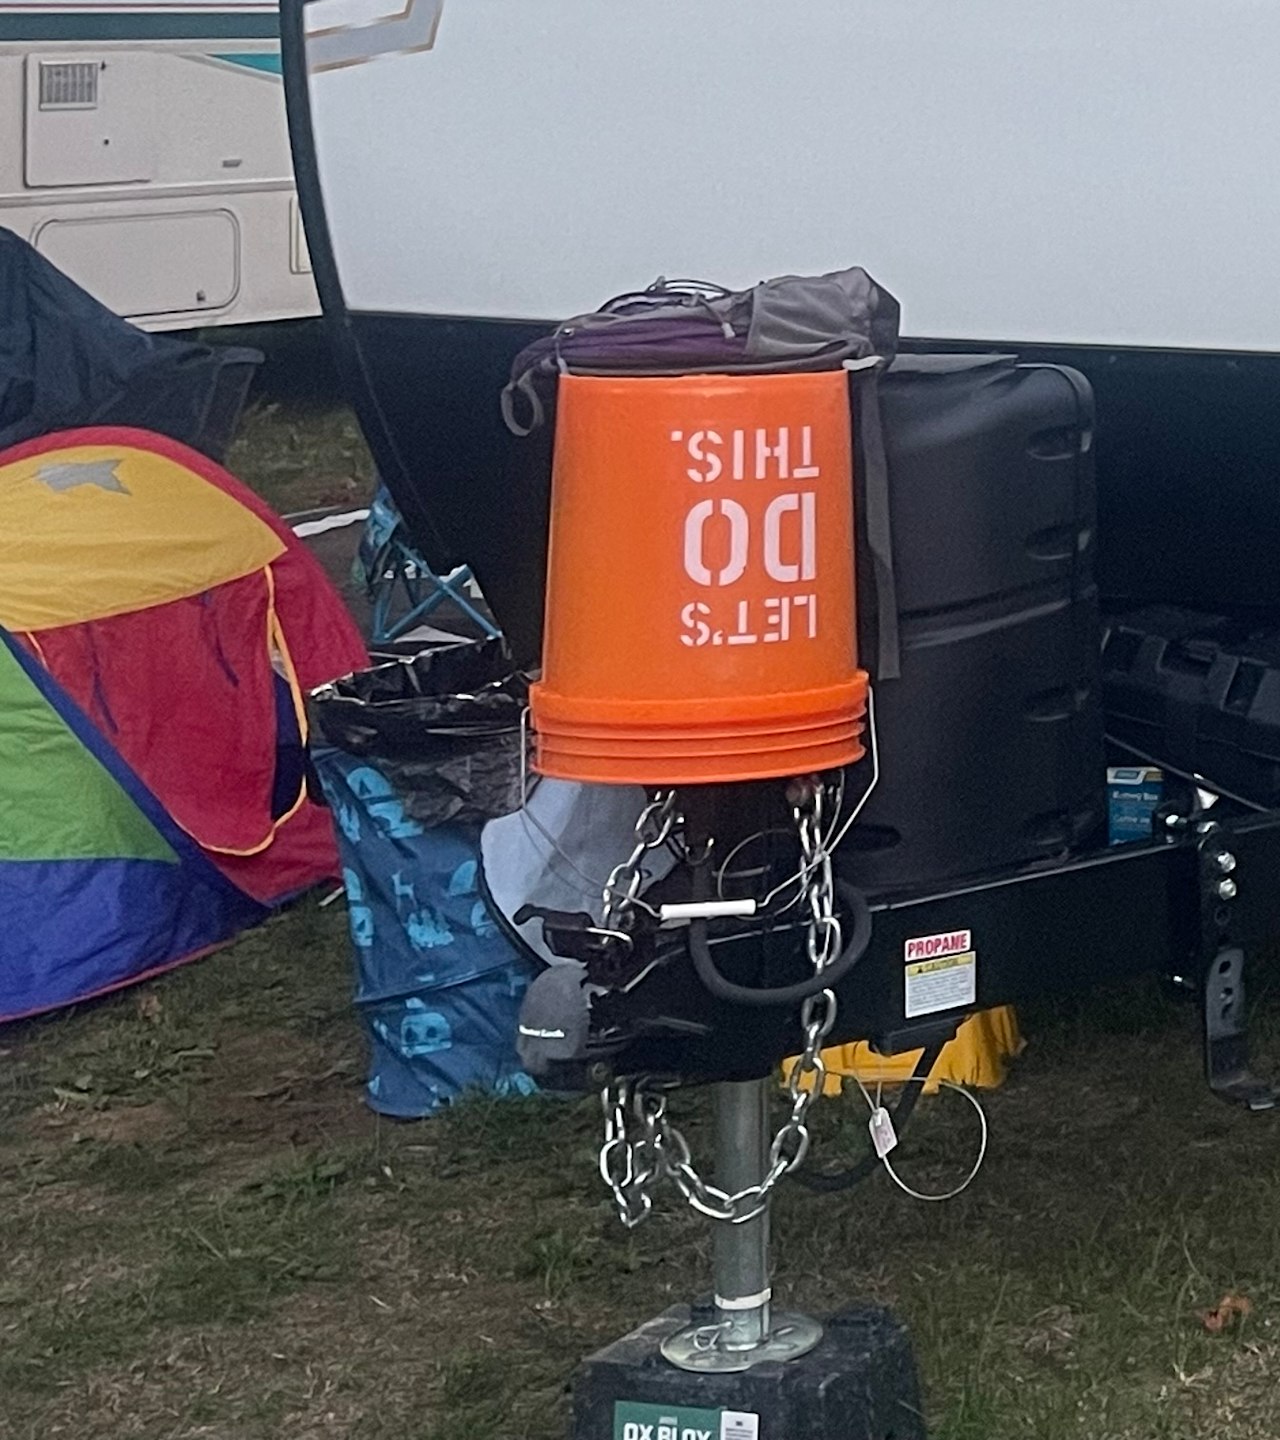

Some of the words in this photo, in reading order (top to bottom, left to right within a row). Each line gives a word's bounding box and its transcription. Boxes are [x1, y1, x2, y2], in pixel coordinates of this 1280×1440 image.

[671, 425, 820, 483] THIS.
[684, 492, 816, 586] DO
[680, 593, 817, 647] LET'S
[907, 932, 967, 958] PROPANE
